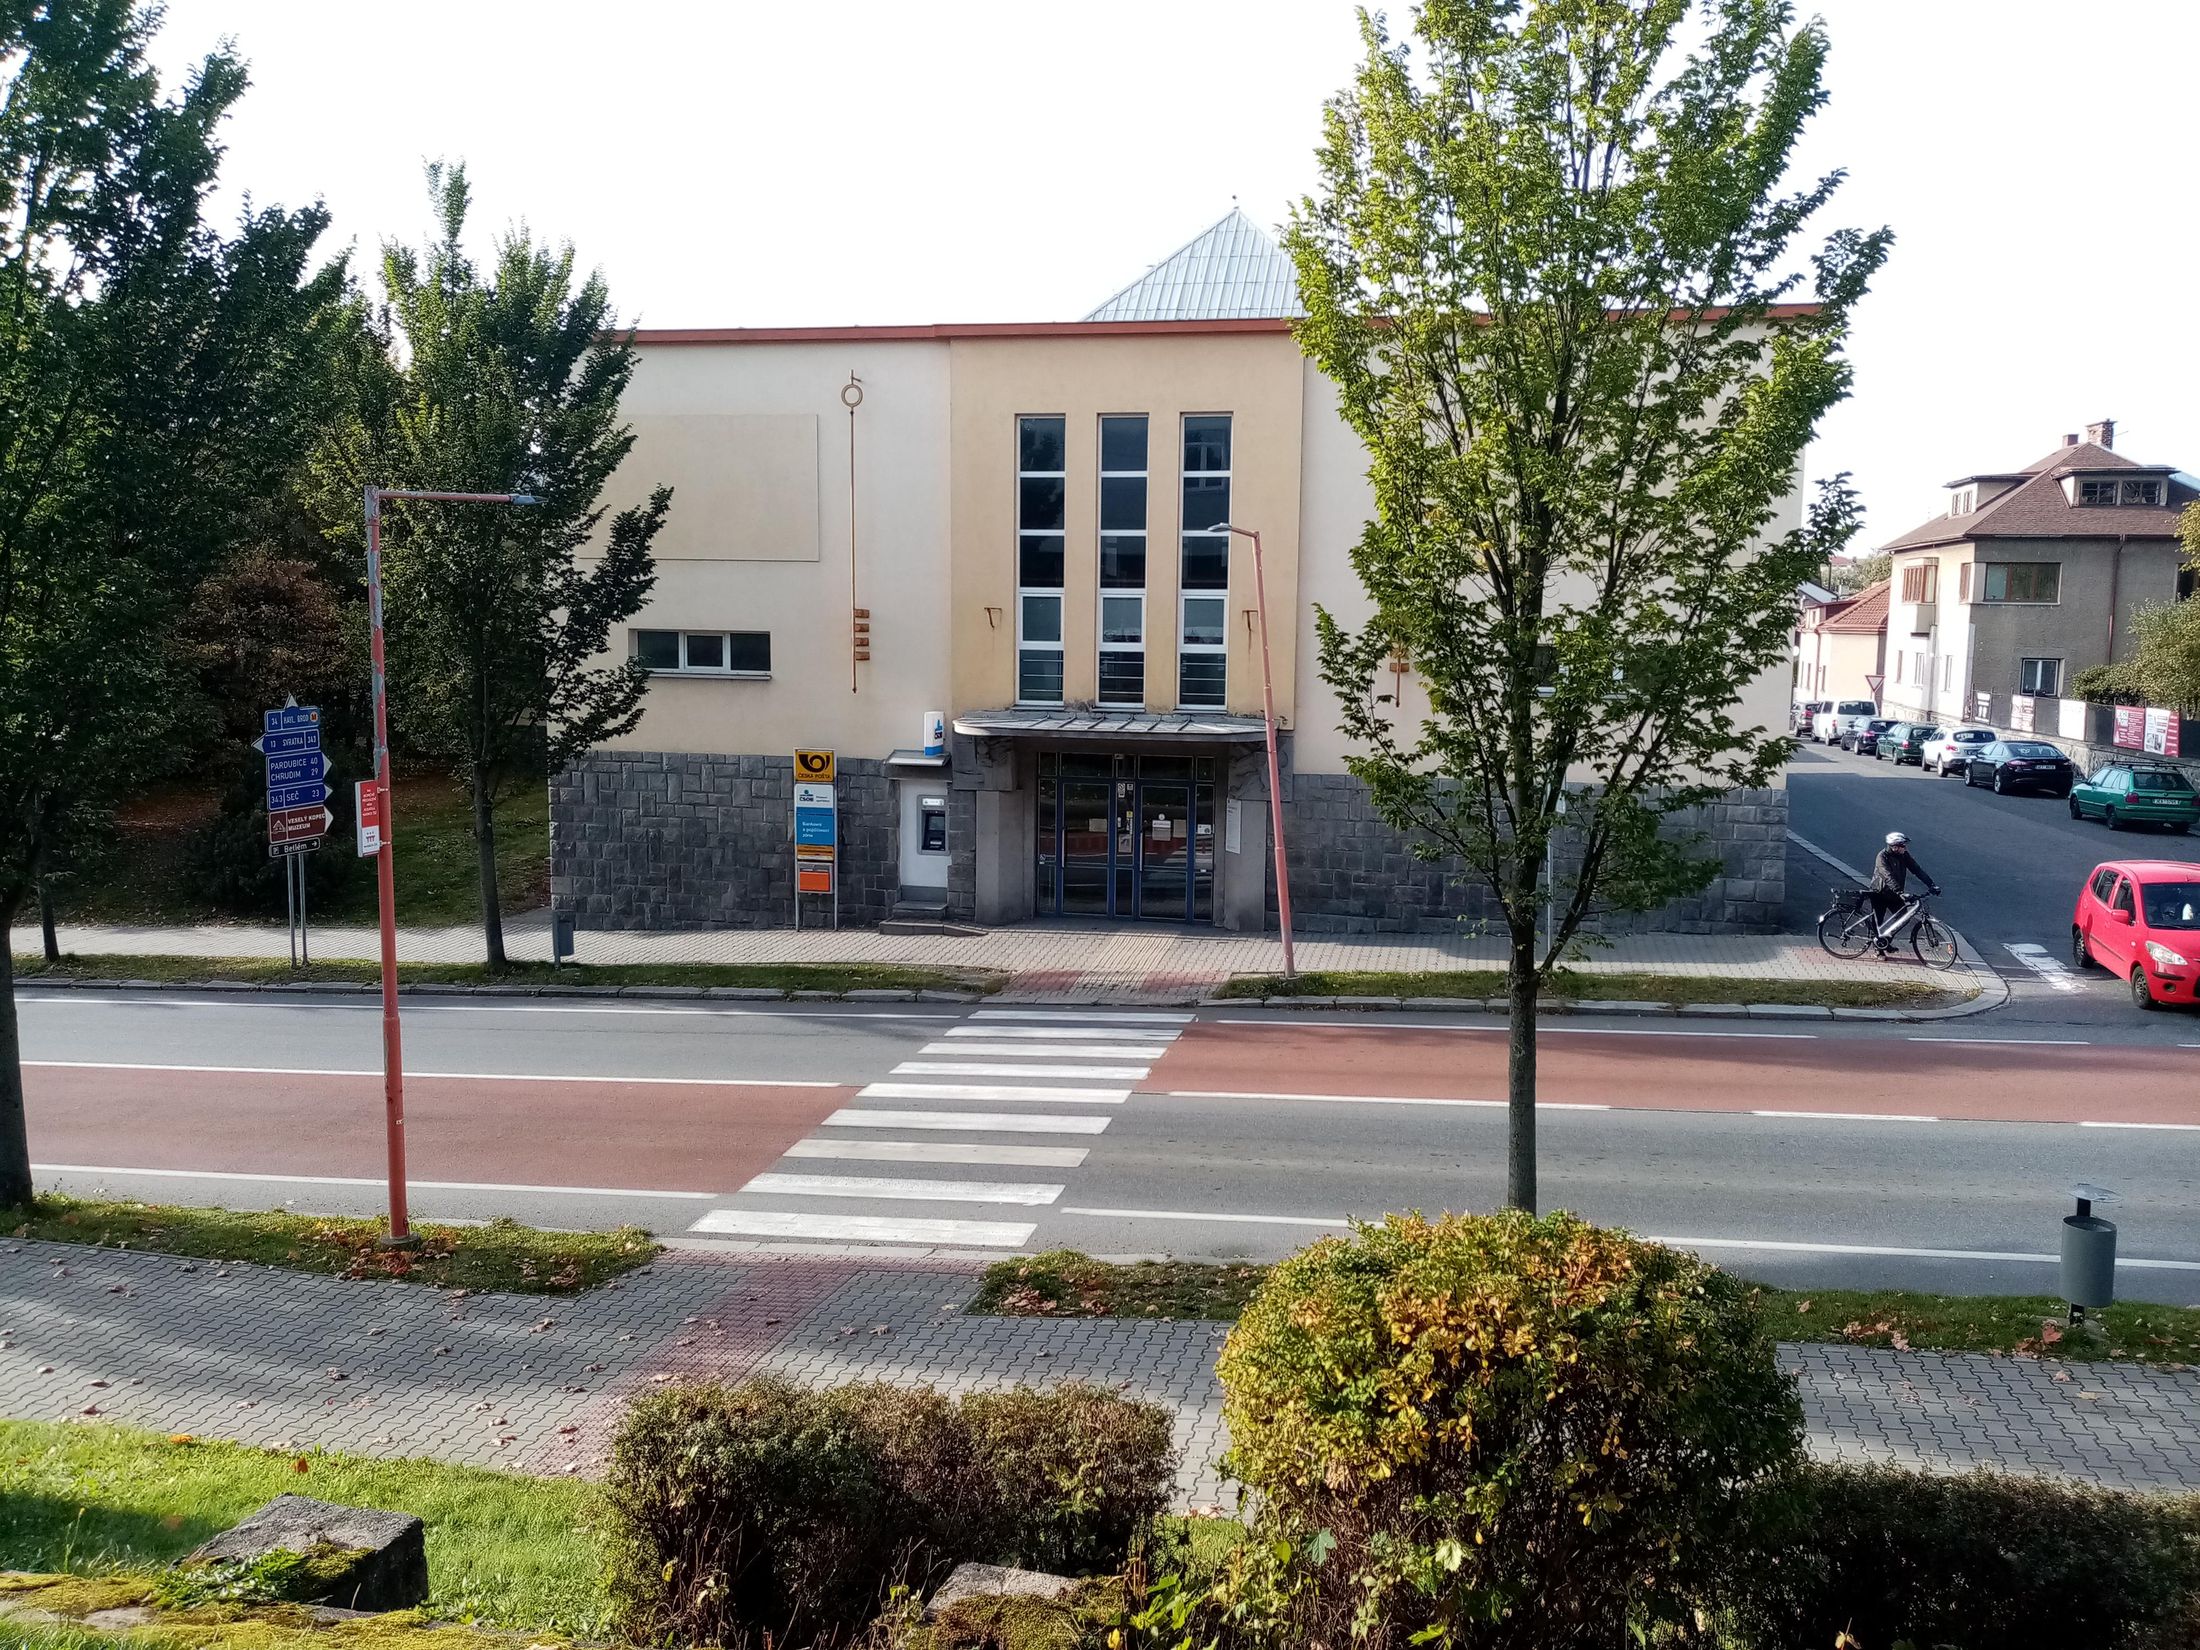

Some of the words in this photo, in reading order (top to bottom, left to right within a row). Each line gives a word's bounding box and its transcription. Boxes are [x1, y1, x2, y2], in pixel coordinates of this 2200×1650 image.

[271, 717, 278, 725] 34
[282, 737, 304, 746] SVRATKA
[307, 735, 317, 744] 343
[270, 758, 307, 770] PARDUBICE
[310, 756, 318, 765] 40
[270, 770, 301, 781] CHRUDIM
[310, 767, 319, 776] 29
[271, 794, 283, 804] 343
[286, 790, 300, 802] SEČ
[287, 815, 308, 824] VESELÝ
[308, 813, 326, 821] KOPEC
[287, 822, 311, 831] MUZEUM
[284, 842, 308, 853] Betlém
